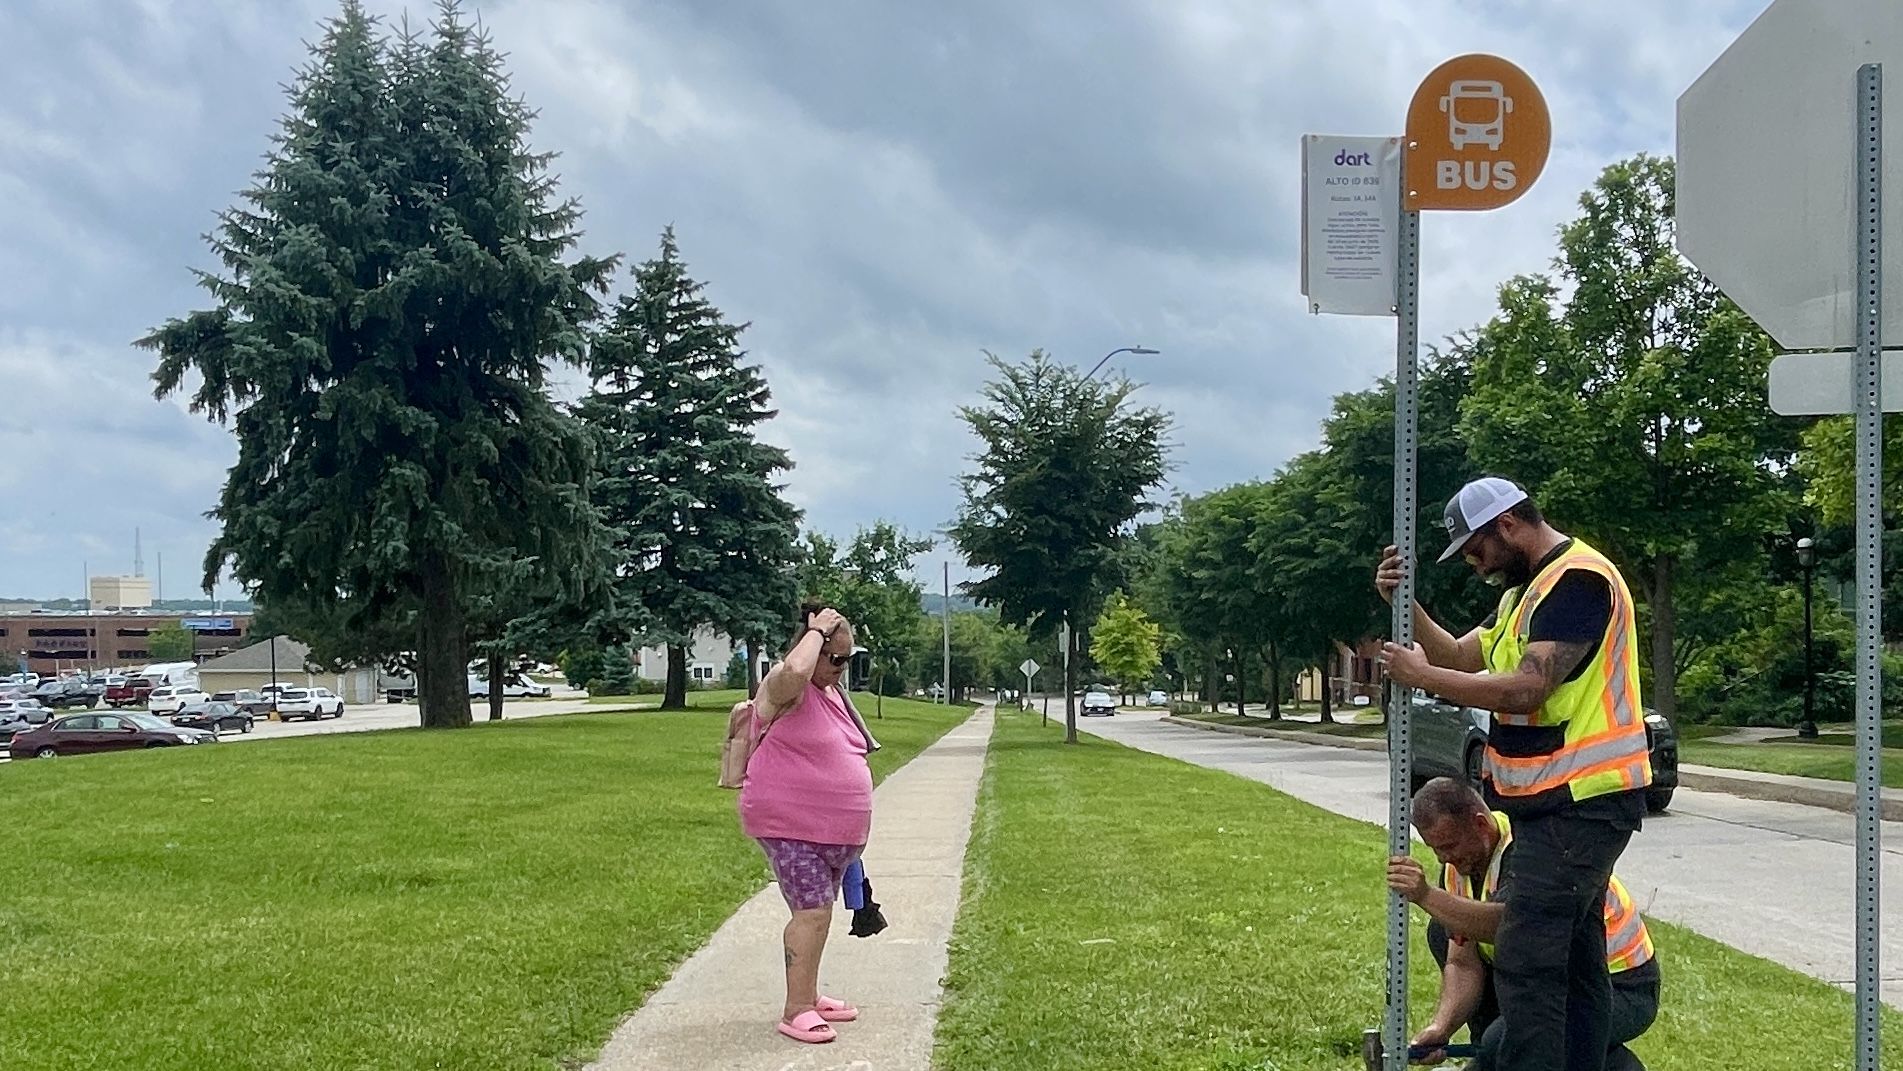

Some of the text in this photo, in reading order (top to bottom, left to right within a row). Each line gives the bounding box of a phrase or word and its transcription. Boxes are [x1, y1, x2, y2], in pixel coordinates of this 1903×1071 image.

[1334, 149, 1373, 166] dart
[1325, 177, 1349, 185] ALTO
[1436, 160, 1517, 190] BUS
